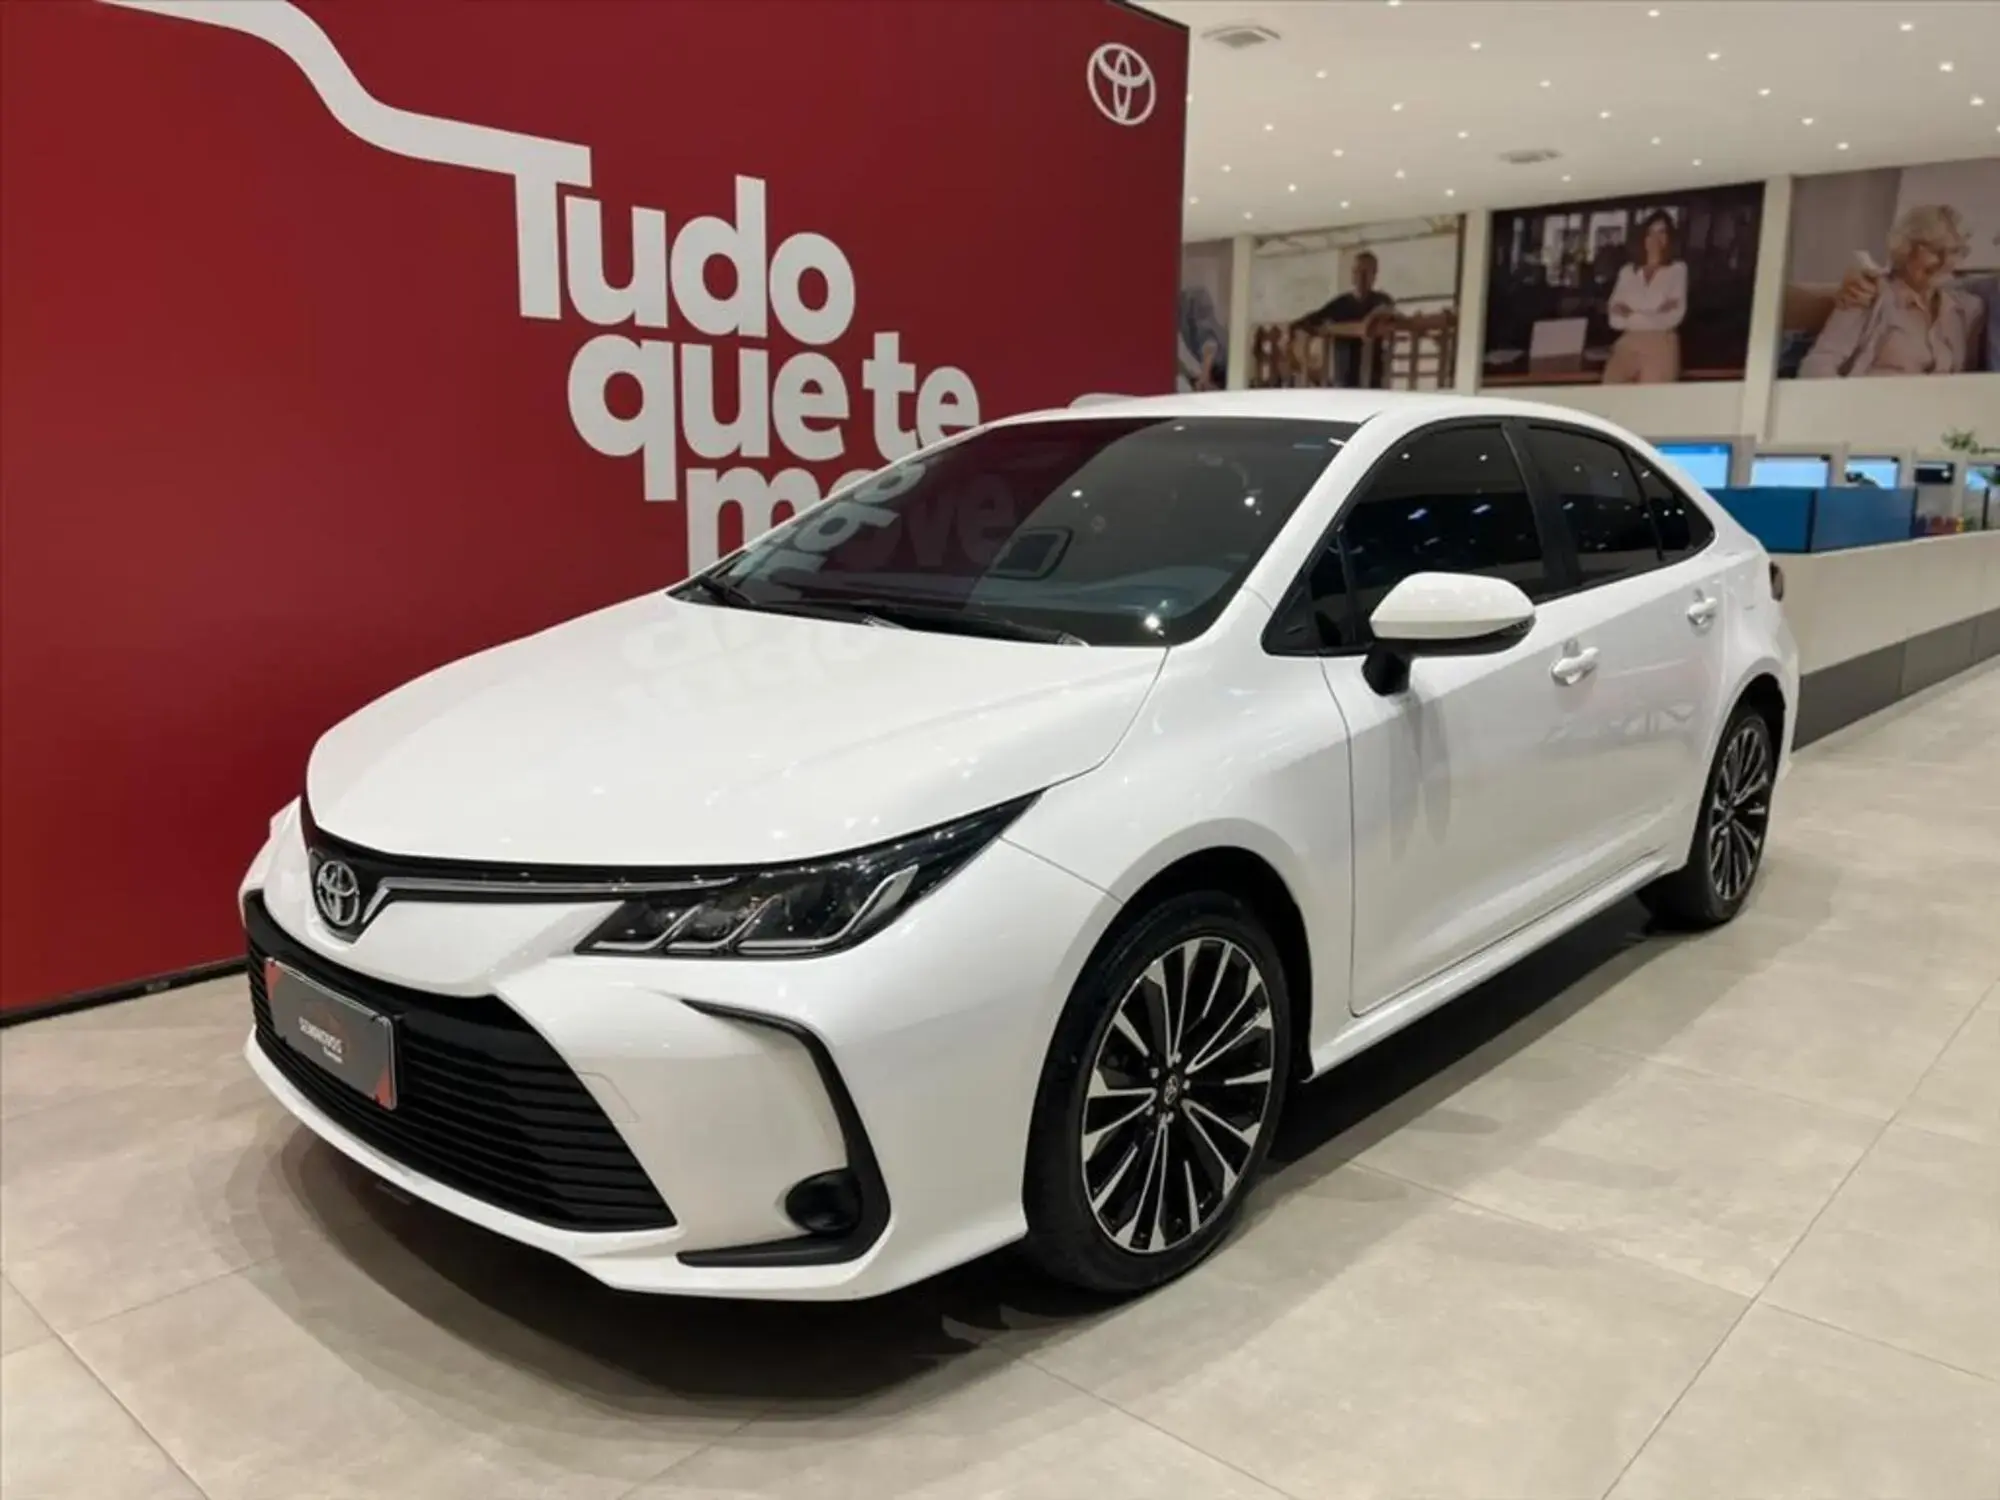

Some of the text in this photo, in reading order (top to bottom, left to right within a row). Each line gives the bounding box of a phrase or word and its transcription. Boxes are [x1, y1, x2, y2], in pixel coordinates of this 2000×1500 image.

[490, 130, 856, 346] Tudo
[567, 330, 980, 502] que te
